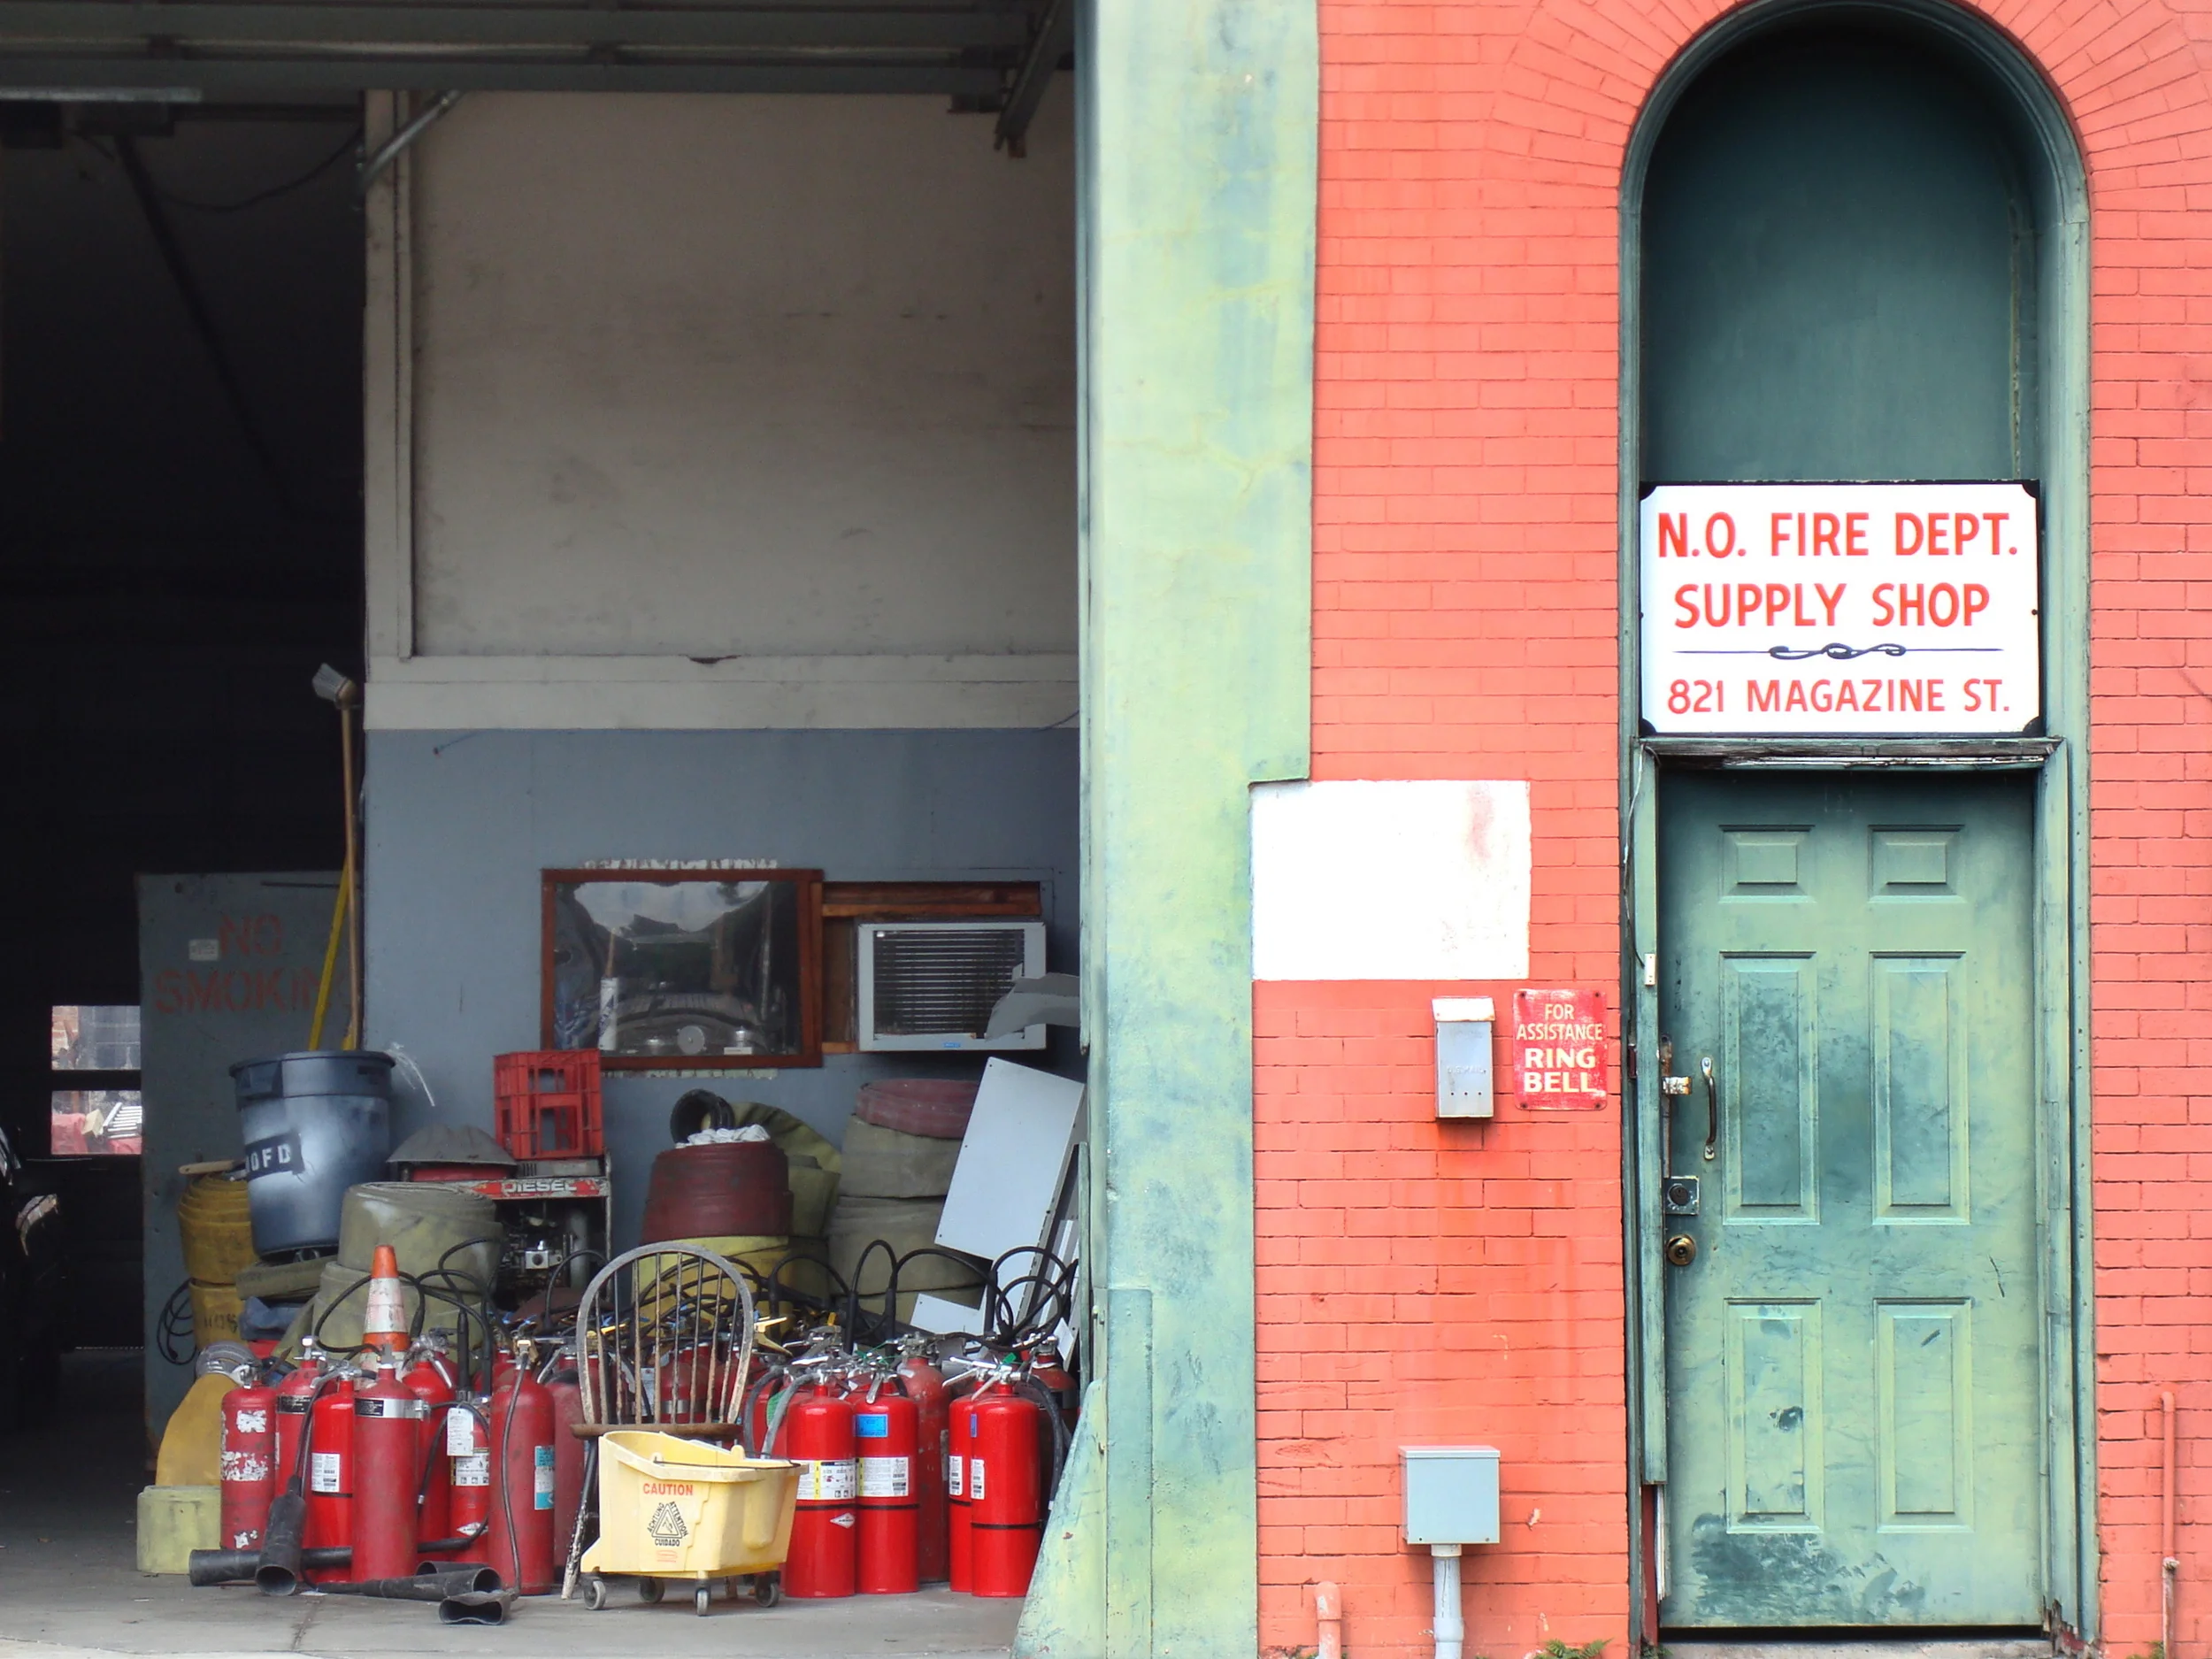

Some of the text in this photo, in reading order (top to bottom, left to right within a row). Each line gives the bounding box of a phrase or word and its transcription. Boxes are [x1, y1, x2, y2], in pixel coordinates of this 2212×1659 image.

[1658, 511, 2017, 558] N.O. FIRE DEPT.
[1674, 582, 1990, 628] SUPPLY SHOP
[1667, 678, 2009, 714] 821 MAGAZINE ST.
[219, 913, 282, 957] NO
[1544, 1003, 1575, 1019] FOR
[1516, 1023, 1603, 1041] ASSISTANCE
[1525, 1048, 1596, 1069] RING
[1523, 1071, 1599, 1094] BELL
[502, 1179, 577, 1193] DIESEL
[643, 1483, 693, 1496] CAUTION
[647, 1502, 664, 1533] ACHTUNG
[669, 1501, 689, 1537] ATTENTION
[655, 1538, 680, 1547] CUIDADO
